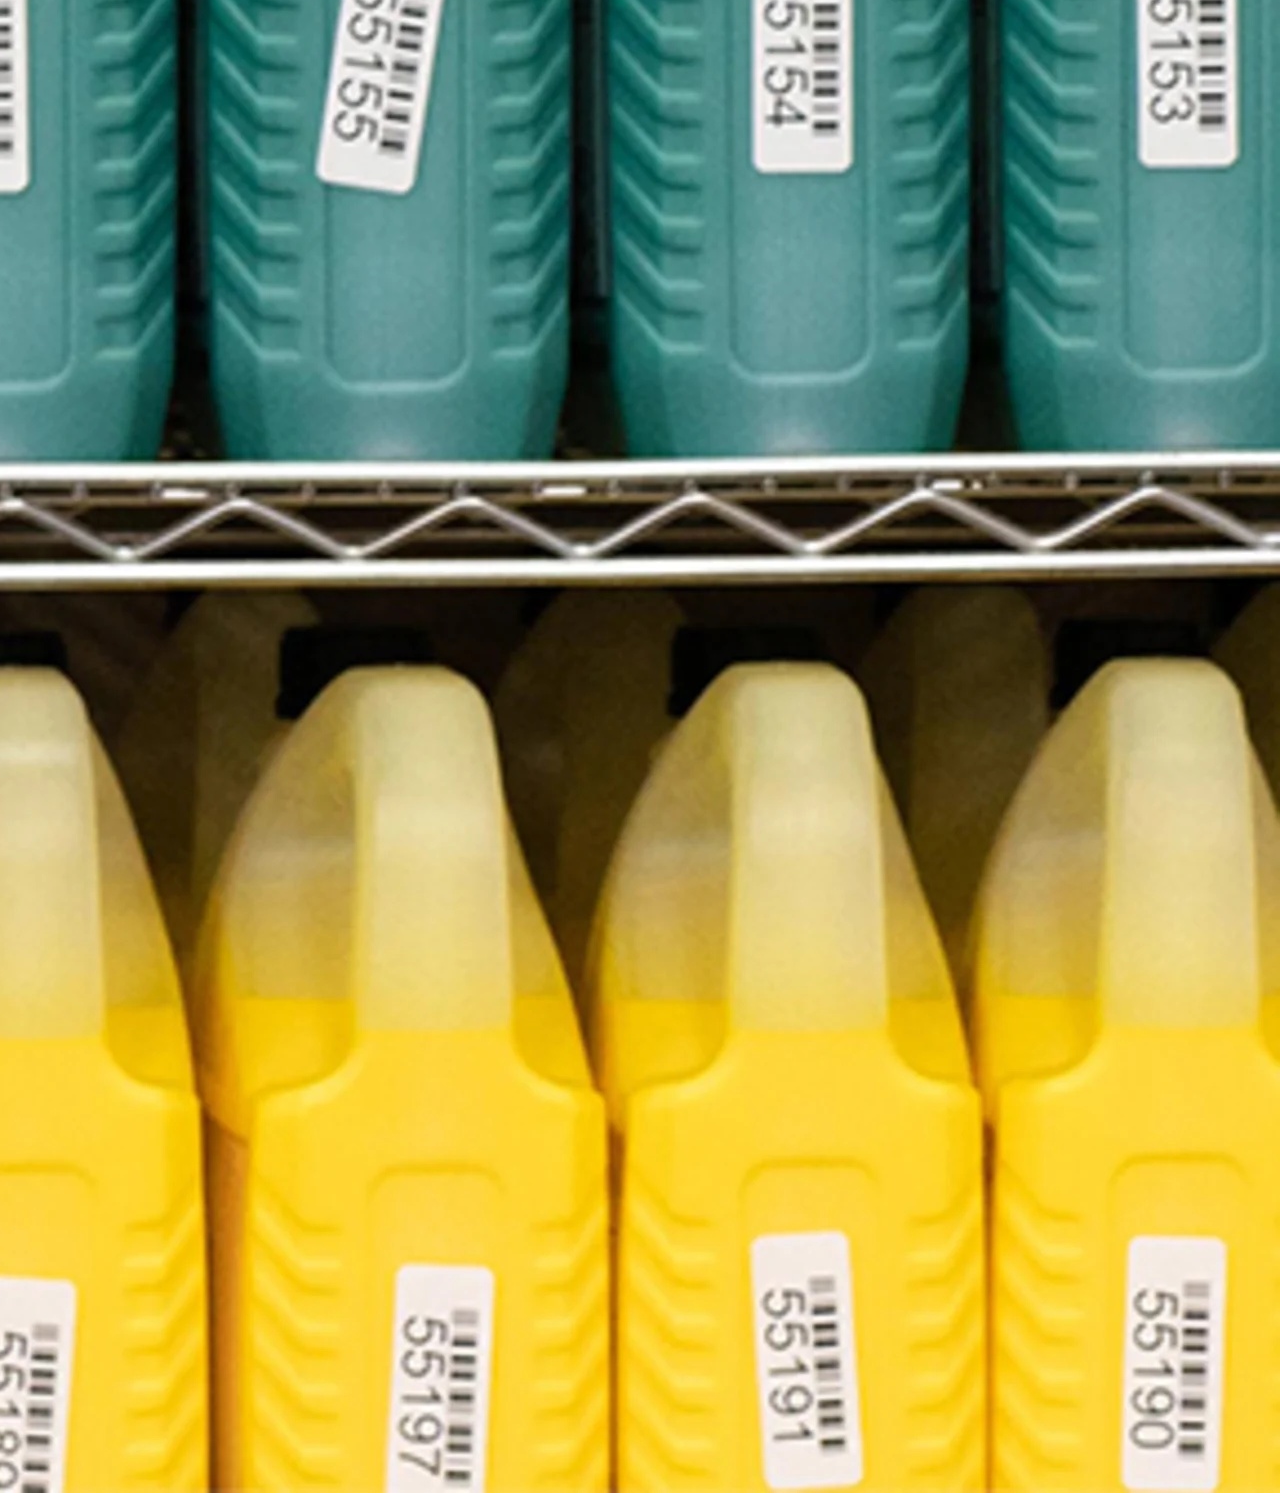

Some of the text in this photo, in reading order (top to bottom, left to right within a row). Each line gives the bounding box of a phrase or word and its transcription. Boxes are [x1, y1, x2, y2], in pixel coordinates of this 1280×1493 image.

[398, 1315, 450, 1478] 55197
[761, 1287, 813, 1446] 55191
[1130, 1287, 1177, 1450] 55190
